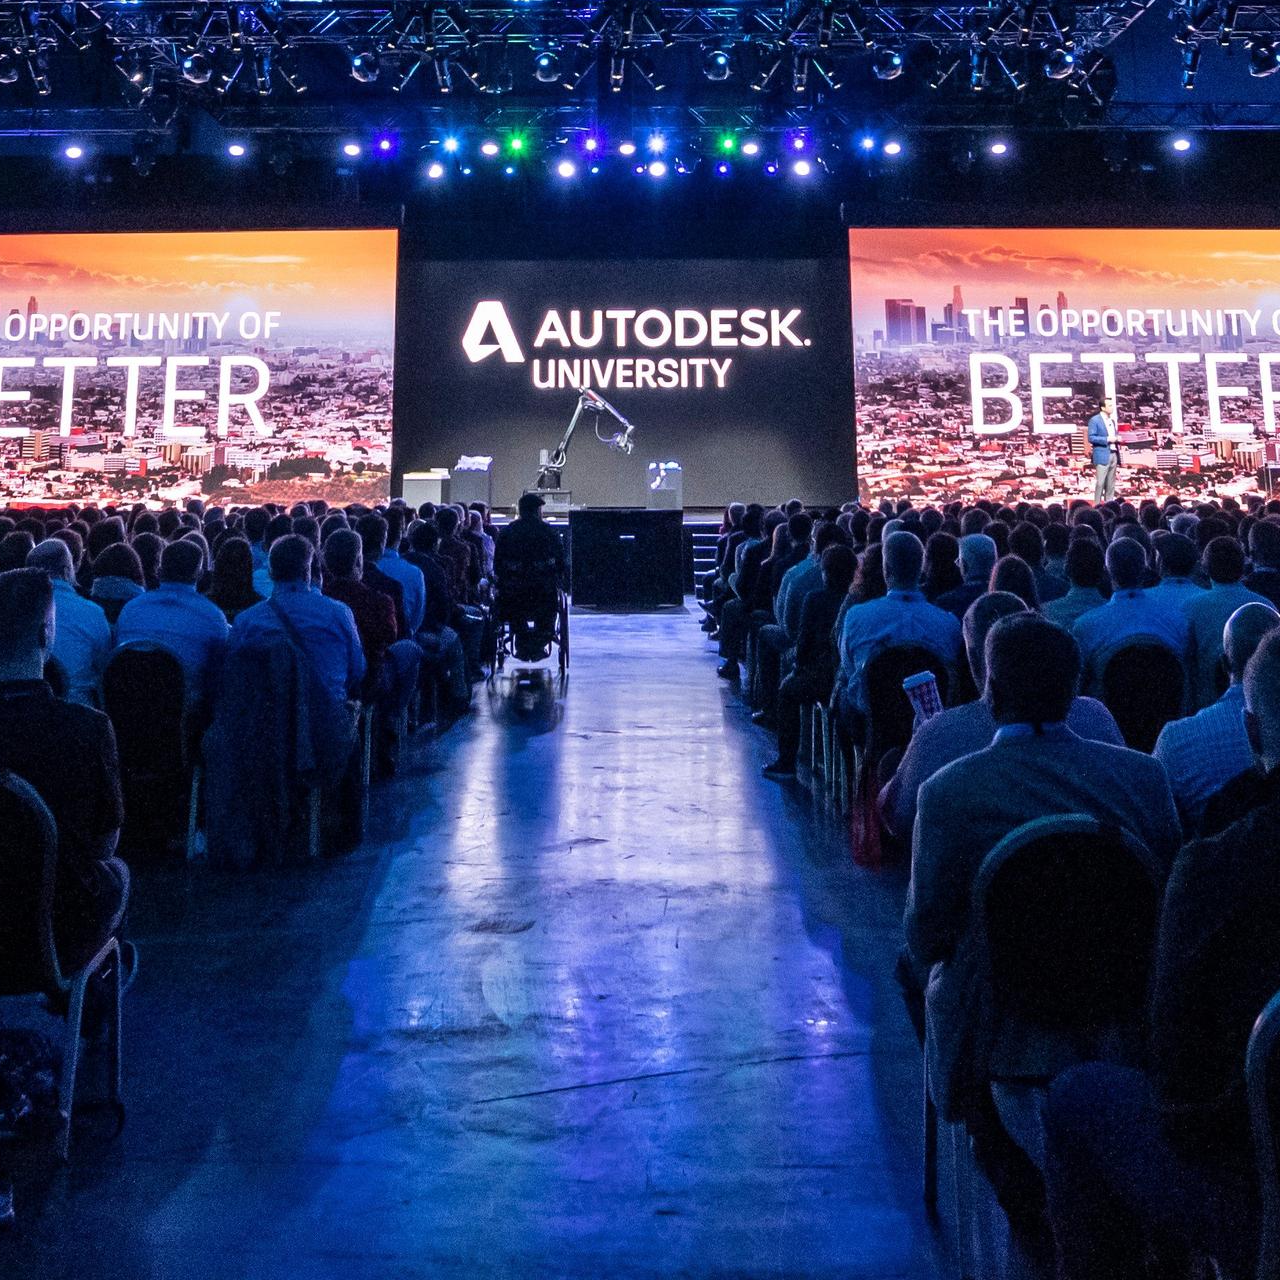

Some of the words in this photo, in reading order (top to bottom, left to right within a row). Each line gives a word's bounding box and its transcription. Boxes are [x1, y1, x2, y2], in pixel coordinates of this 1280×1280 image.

[4, 311, 230, 341] OPPORTUNITY
[239, 310, 281, 339] OF
[533, 308, 812, 348] AUTODESK.
[962, 308, 1025, 337] THE
[1036, 308, 1262, 337] OPPORTUNITY
[533, 358, 732, 389] UNIVERSITY
